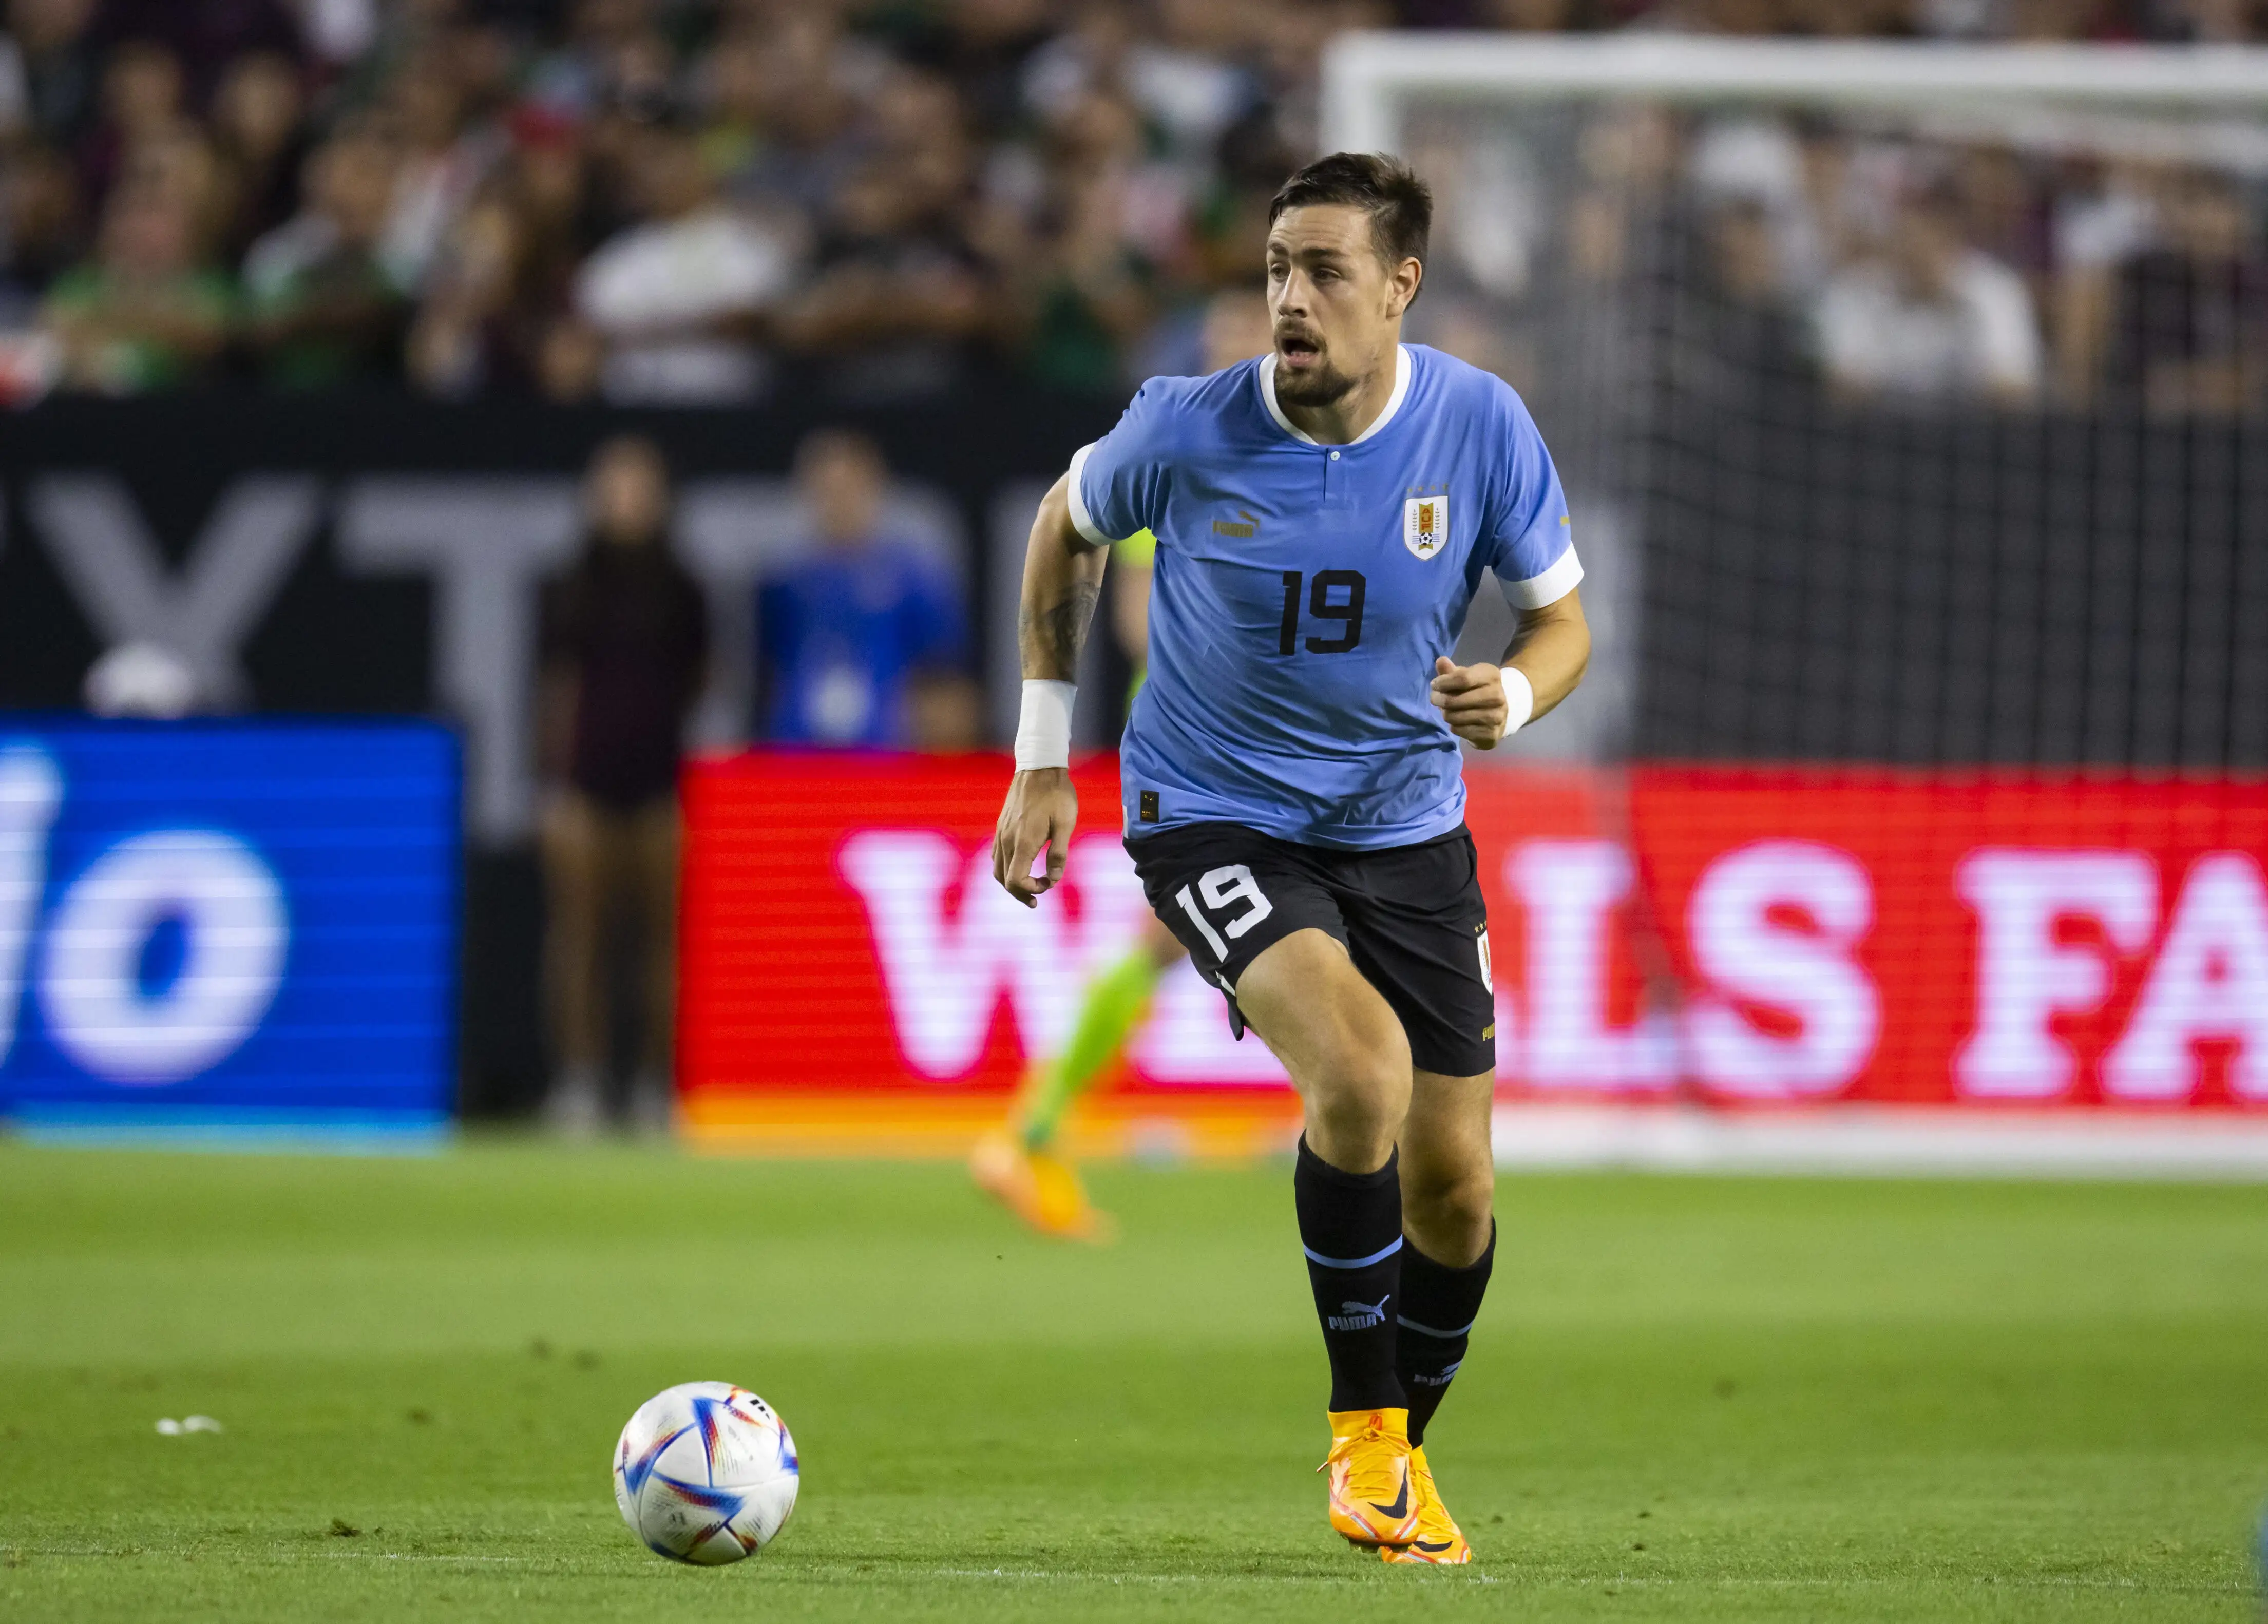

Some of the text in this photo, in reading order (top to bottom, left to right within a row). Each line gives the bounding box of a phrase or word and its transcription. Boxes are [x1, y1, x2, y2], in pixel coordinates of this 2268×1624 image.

[1421, 508, 1431, 530] AUF
[1279, 569, 1366, 656] 19
[1175, 864, 1273, 963] 19
[1328, 1313, 1377, 1331] PUMA
